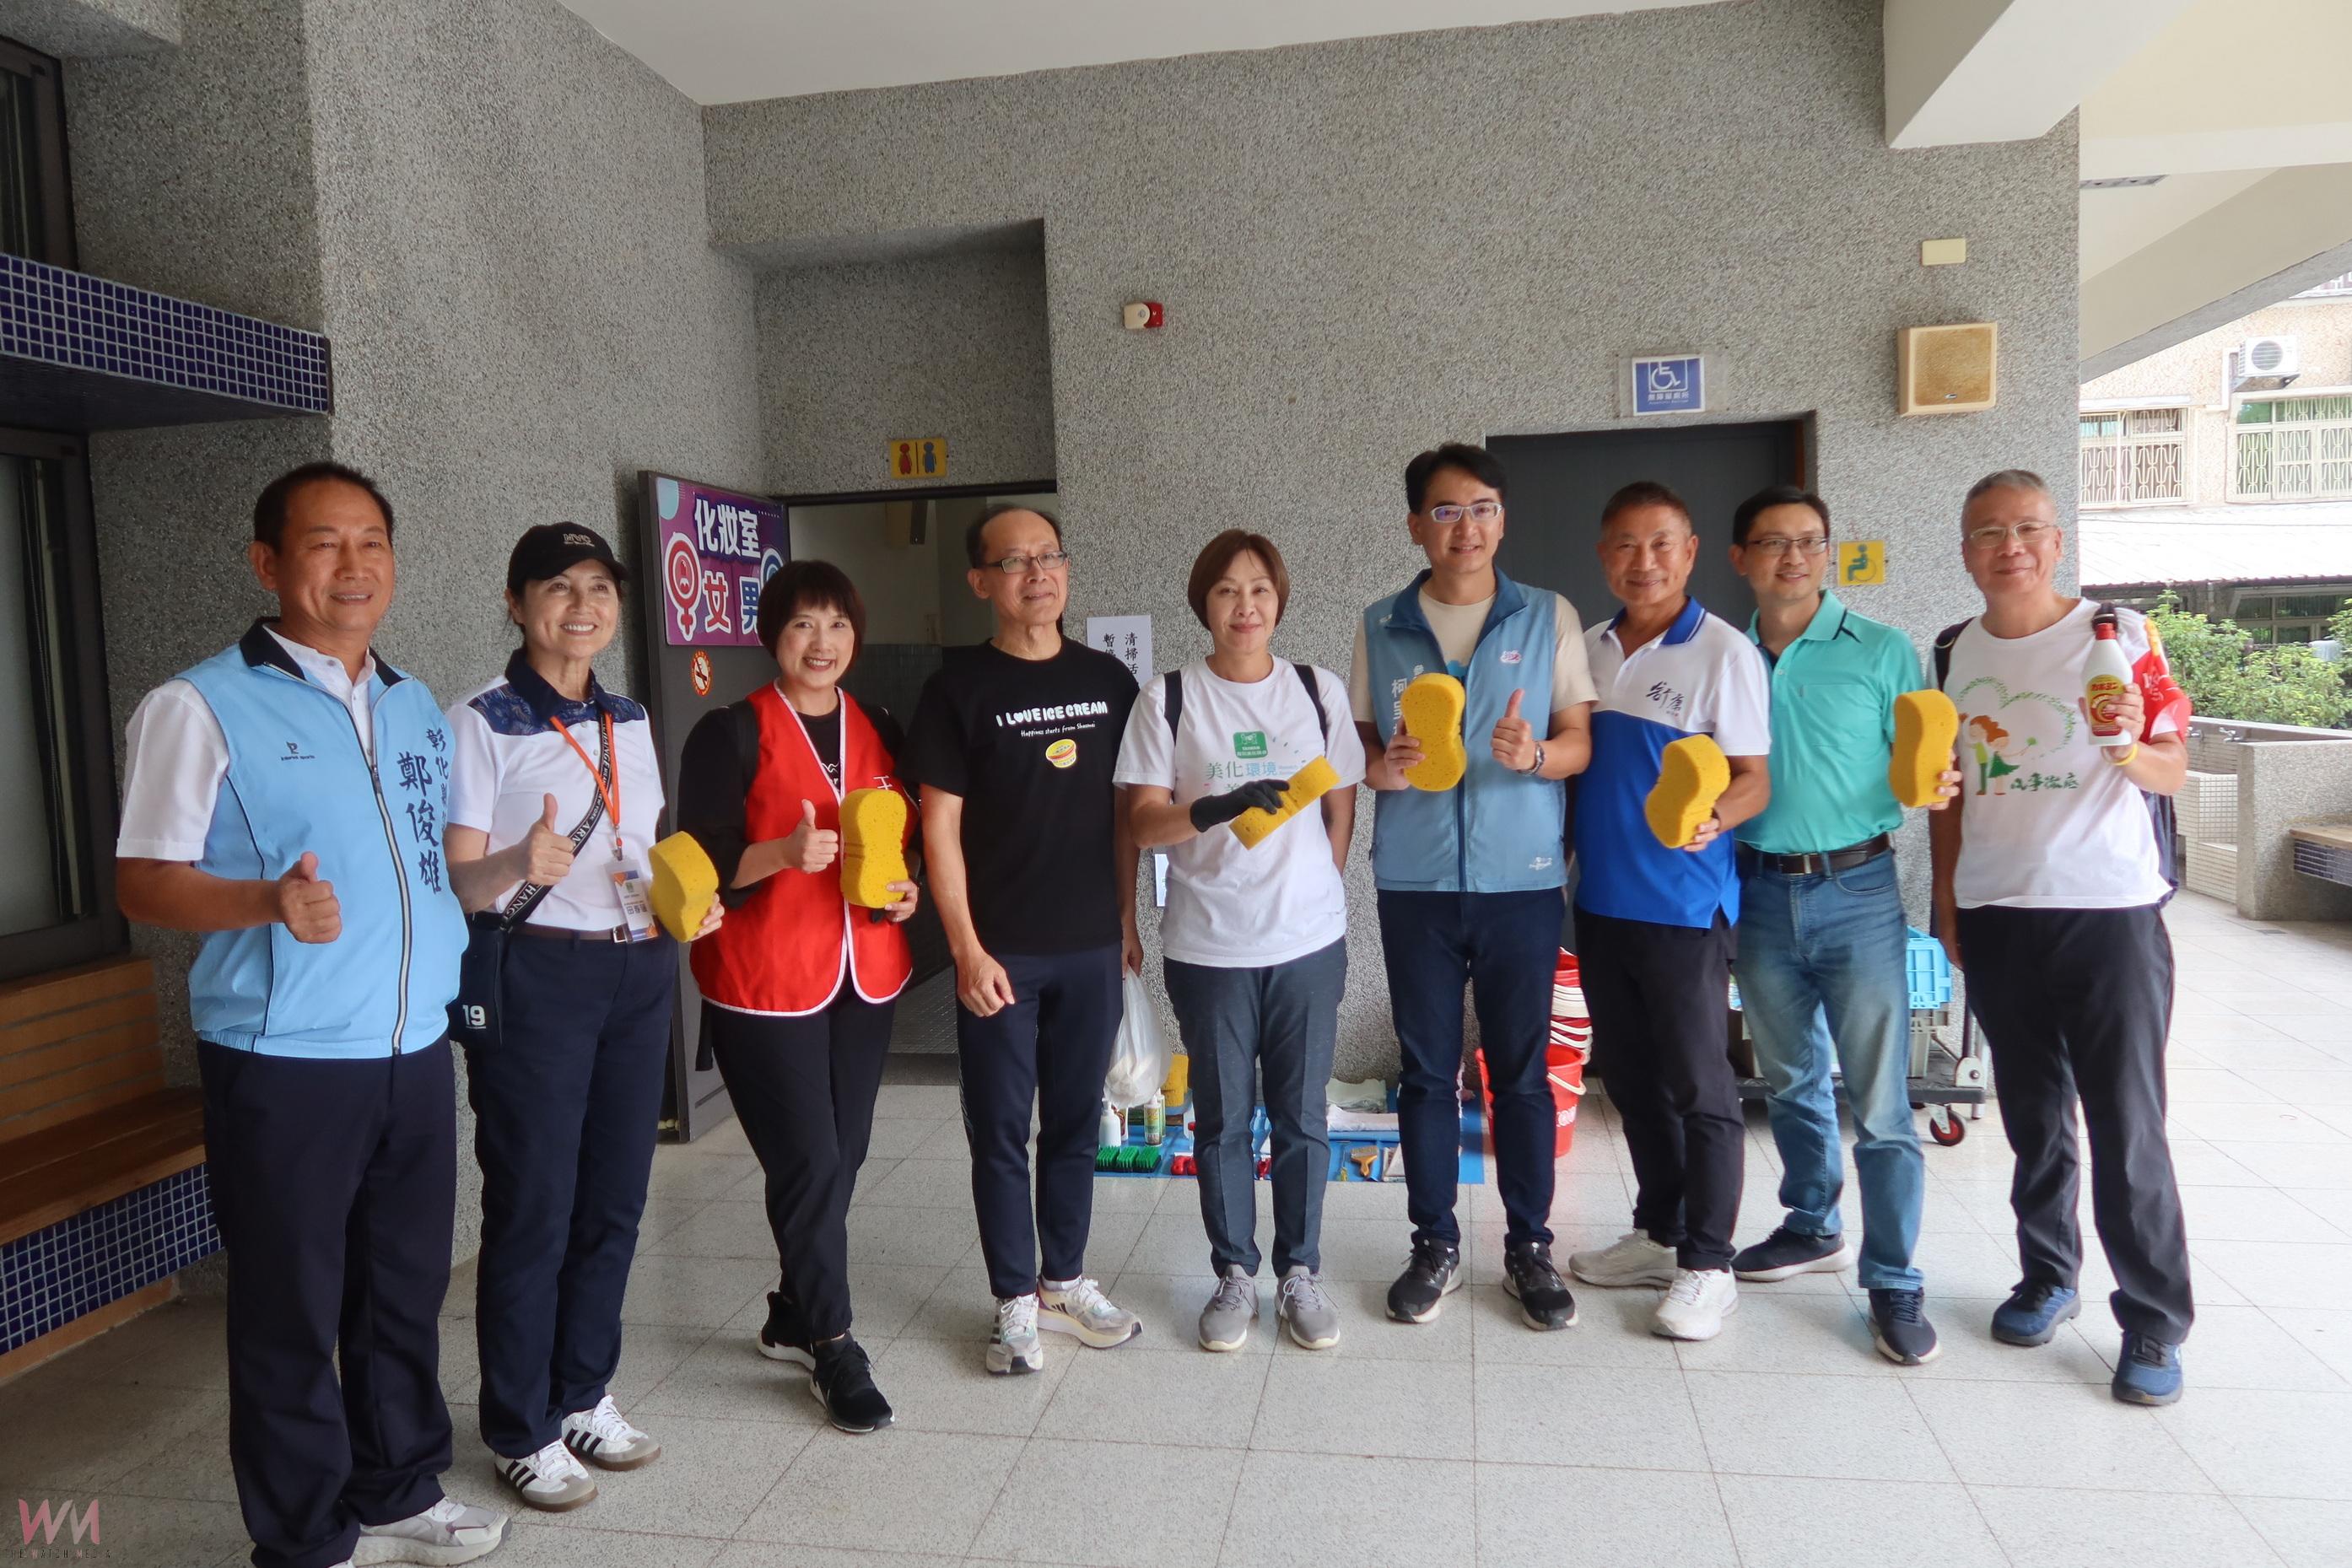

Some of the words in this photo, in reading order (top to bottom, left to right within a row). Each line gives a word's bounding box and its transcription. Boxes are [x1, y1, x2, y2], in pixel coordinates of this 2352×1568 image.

[694, 498, 761, 558] 化妝室
[702, 570, 731, 634] 女
[1043, 706, 1065, 721] ICE
[1065, 701, 1109, 717] CREAM
[1206, 760, 1276, 779] 美化環境
[396, 752, 441, 894] 鄭俊雄
[462, 1004, 486, 1026] 19
